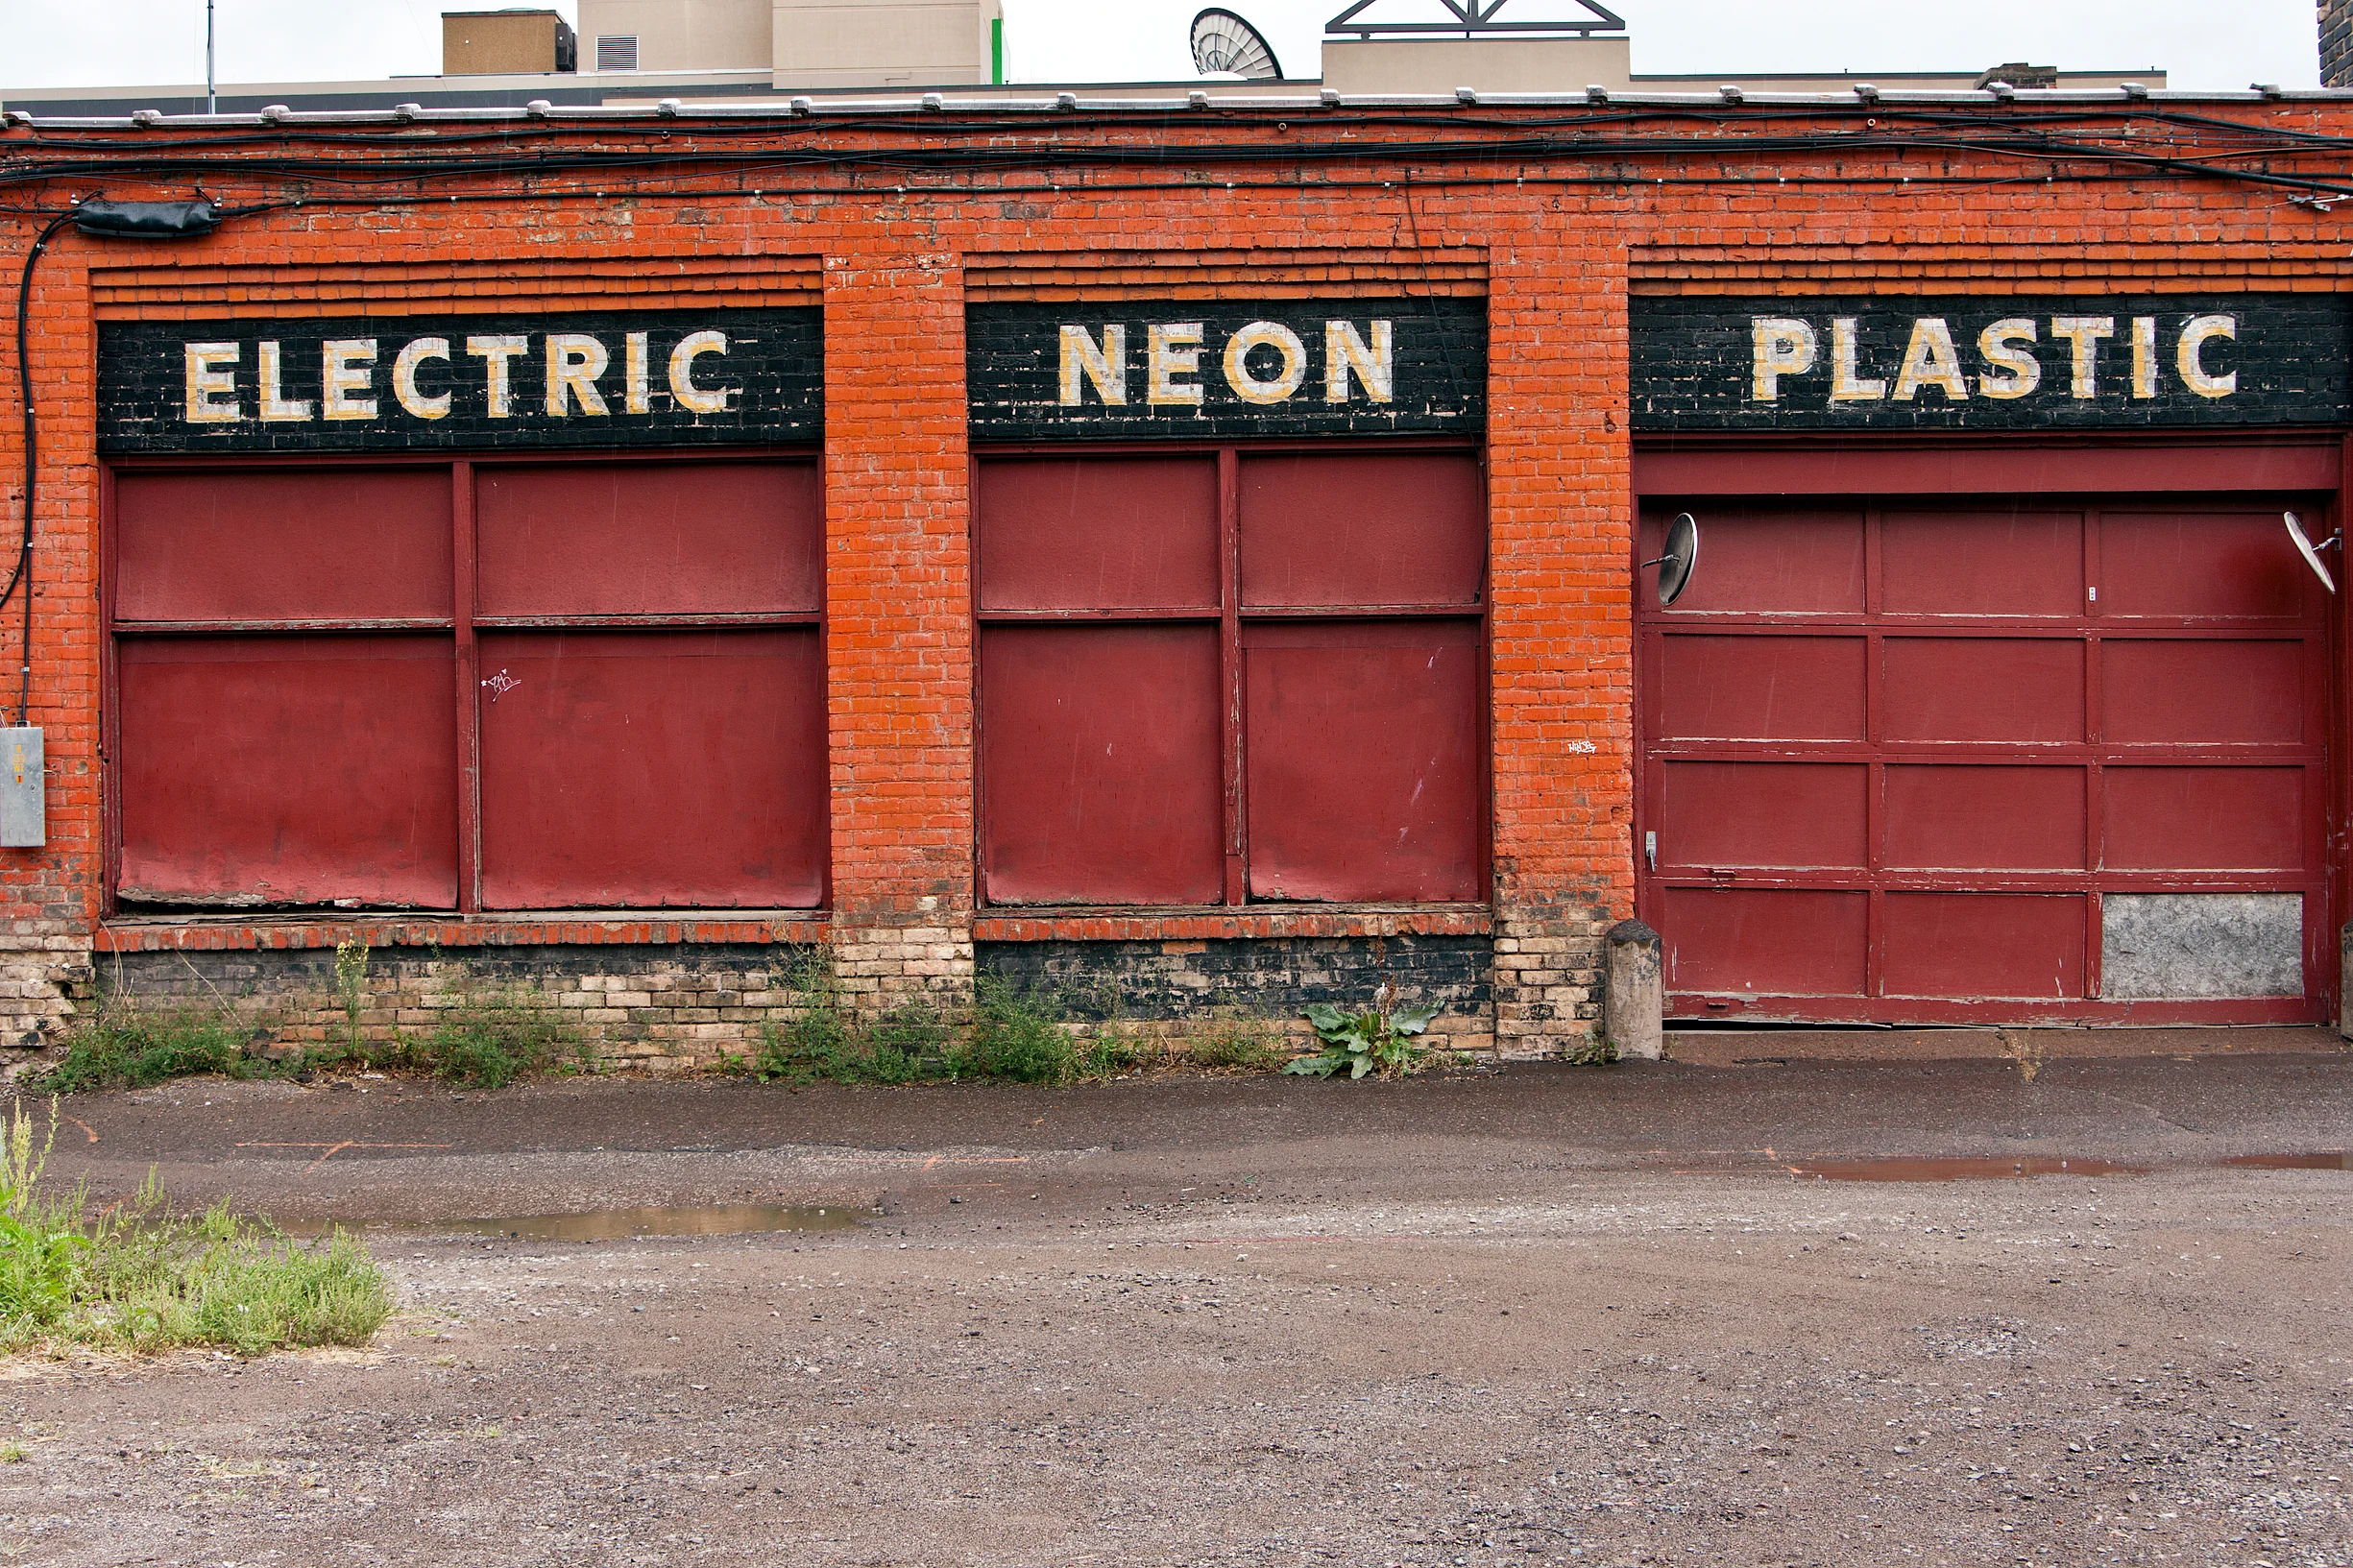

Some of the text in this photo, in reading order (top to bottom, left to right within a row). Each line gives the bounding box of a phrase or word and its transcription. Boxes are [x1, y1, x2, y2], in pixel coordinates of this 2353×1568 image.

[183, 330, 728, 424] ELECTRIC
[1058, 320, 1394, 407] NEON
[1751, 315, 2238, 402] PLASTIC
